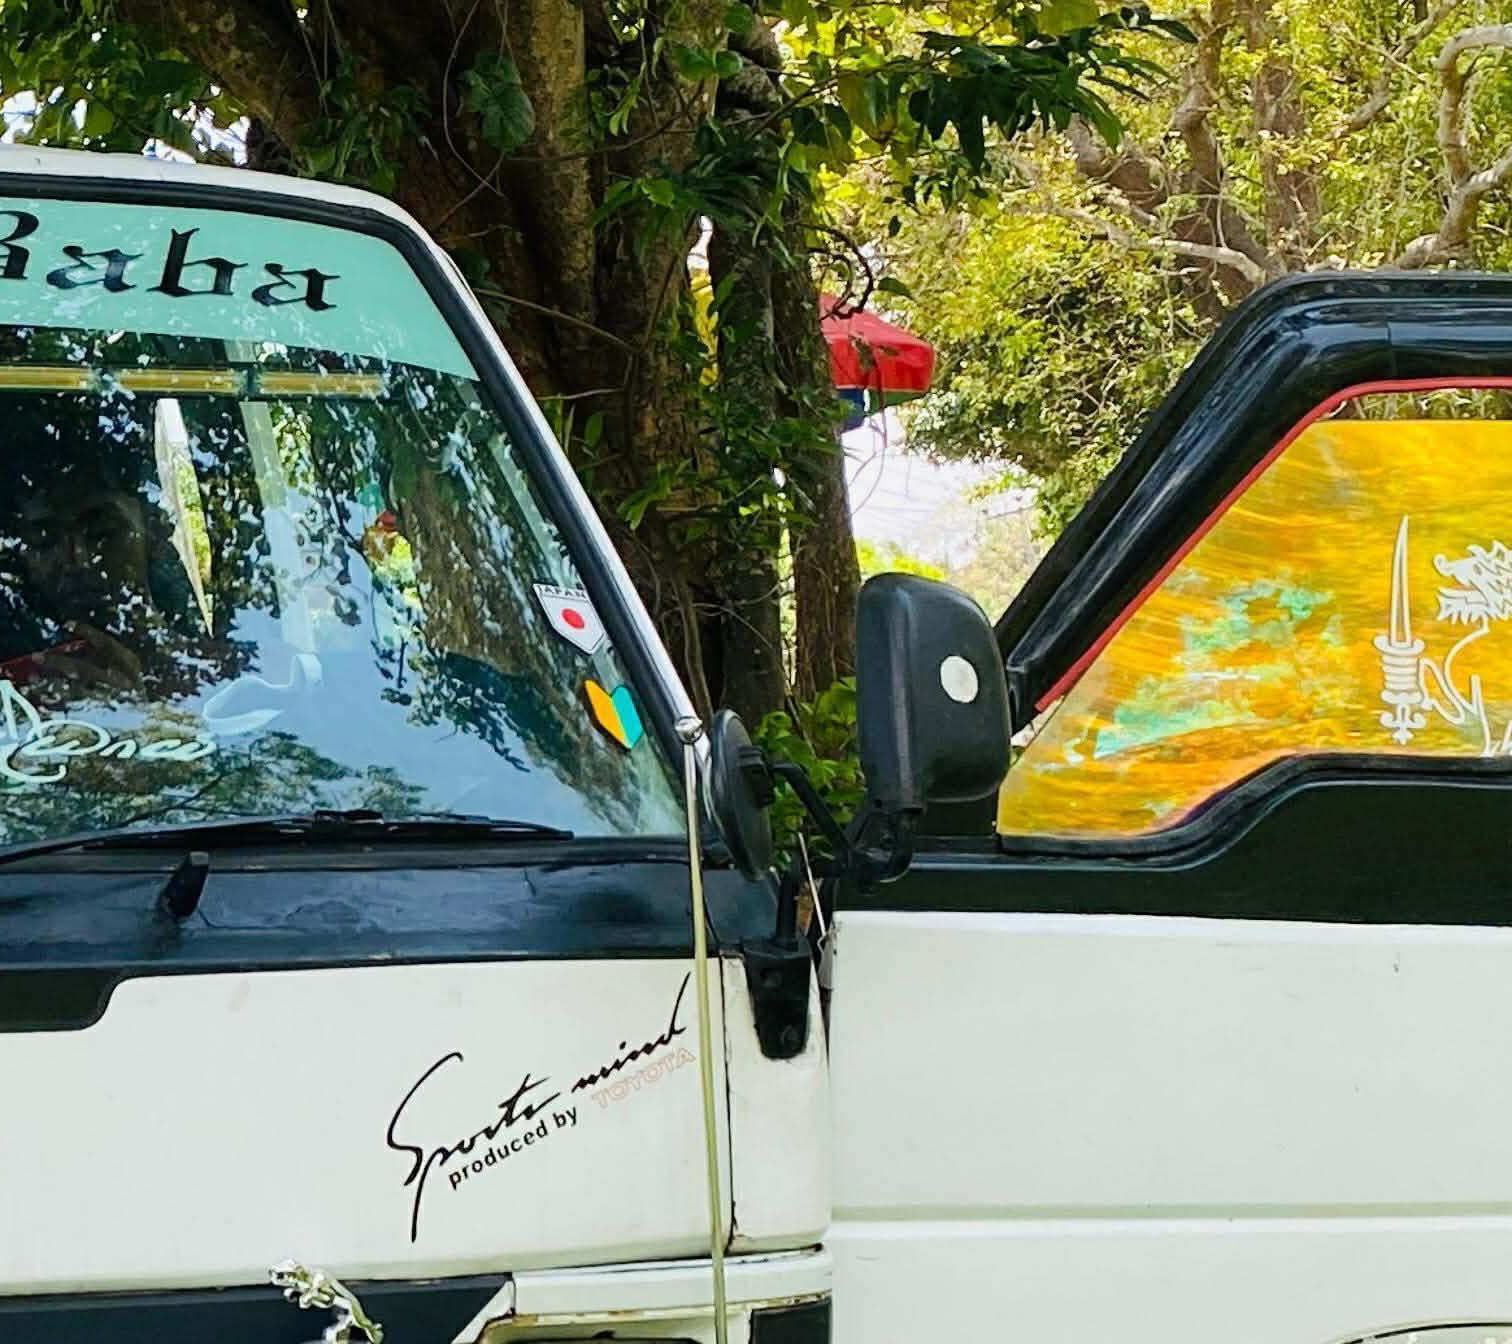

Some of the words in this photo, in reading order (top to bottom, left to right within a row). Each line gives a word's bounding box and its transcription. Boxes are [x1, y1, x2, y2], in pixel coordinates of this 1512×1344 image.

[537, 584, 587, 599] JAPAN
[570, 970, 692, 1094] mind
[448, 1118, 550, 1191] produced
[552, 1105, 579, 1127] by
[591, 1046, 697, 1109] TOYOTA
